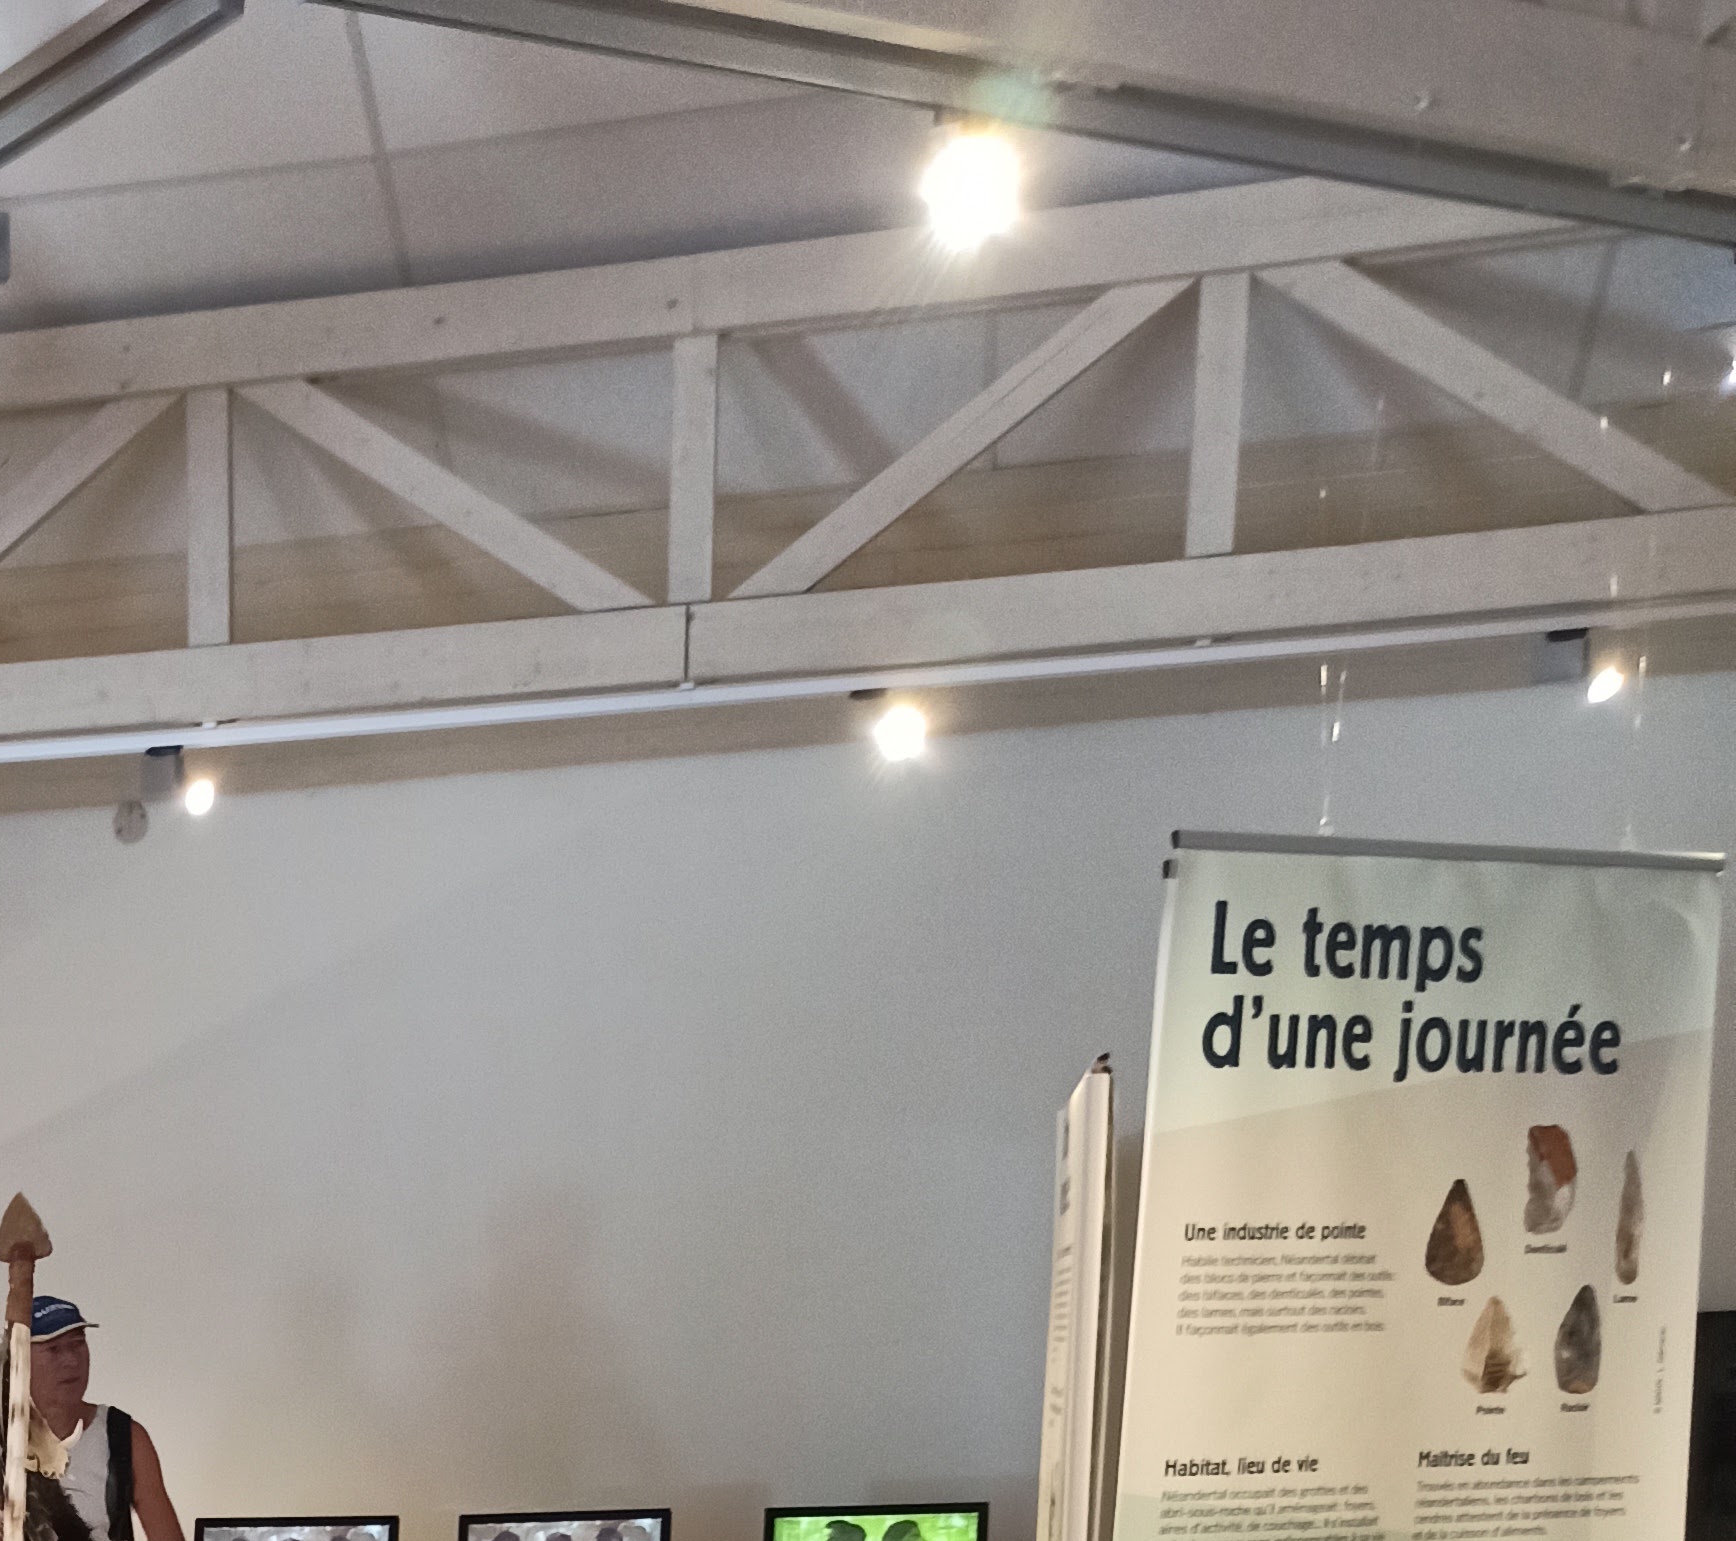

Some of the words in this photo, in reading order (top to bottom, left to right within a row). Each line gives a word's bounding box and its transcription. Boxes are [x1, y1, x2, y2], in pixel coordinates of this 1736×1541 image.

[1211, 900, 1276, 976] Le
[1302, 907, 1484, 993] temps
[1393, 1000, 1621, 1083] journée
[1185, 1223, 1216, 1241] Une
[1223, 1222, 1289, 1240] industrie
[1296, 1222, 1315, 1239] de
[1321, 1222, 1366, 1241] pointe
[1165, 1459, 1231, 1477] Habitat,
[1237, 1457, 1265, 1475] lieu
[1272, 1456, 1291, 1473] de
[1297, 1456, 1319, 1472] vie
[1481, 1449, 1500, 1465] du
[1505, 1448, 1530, 1464] feu
